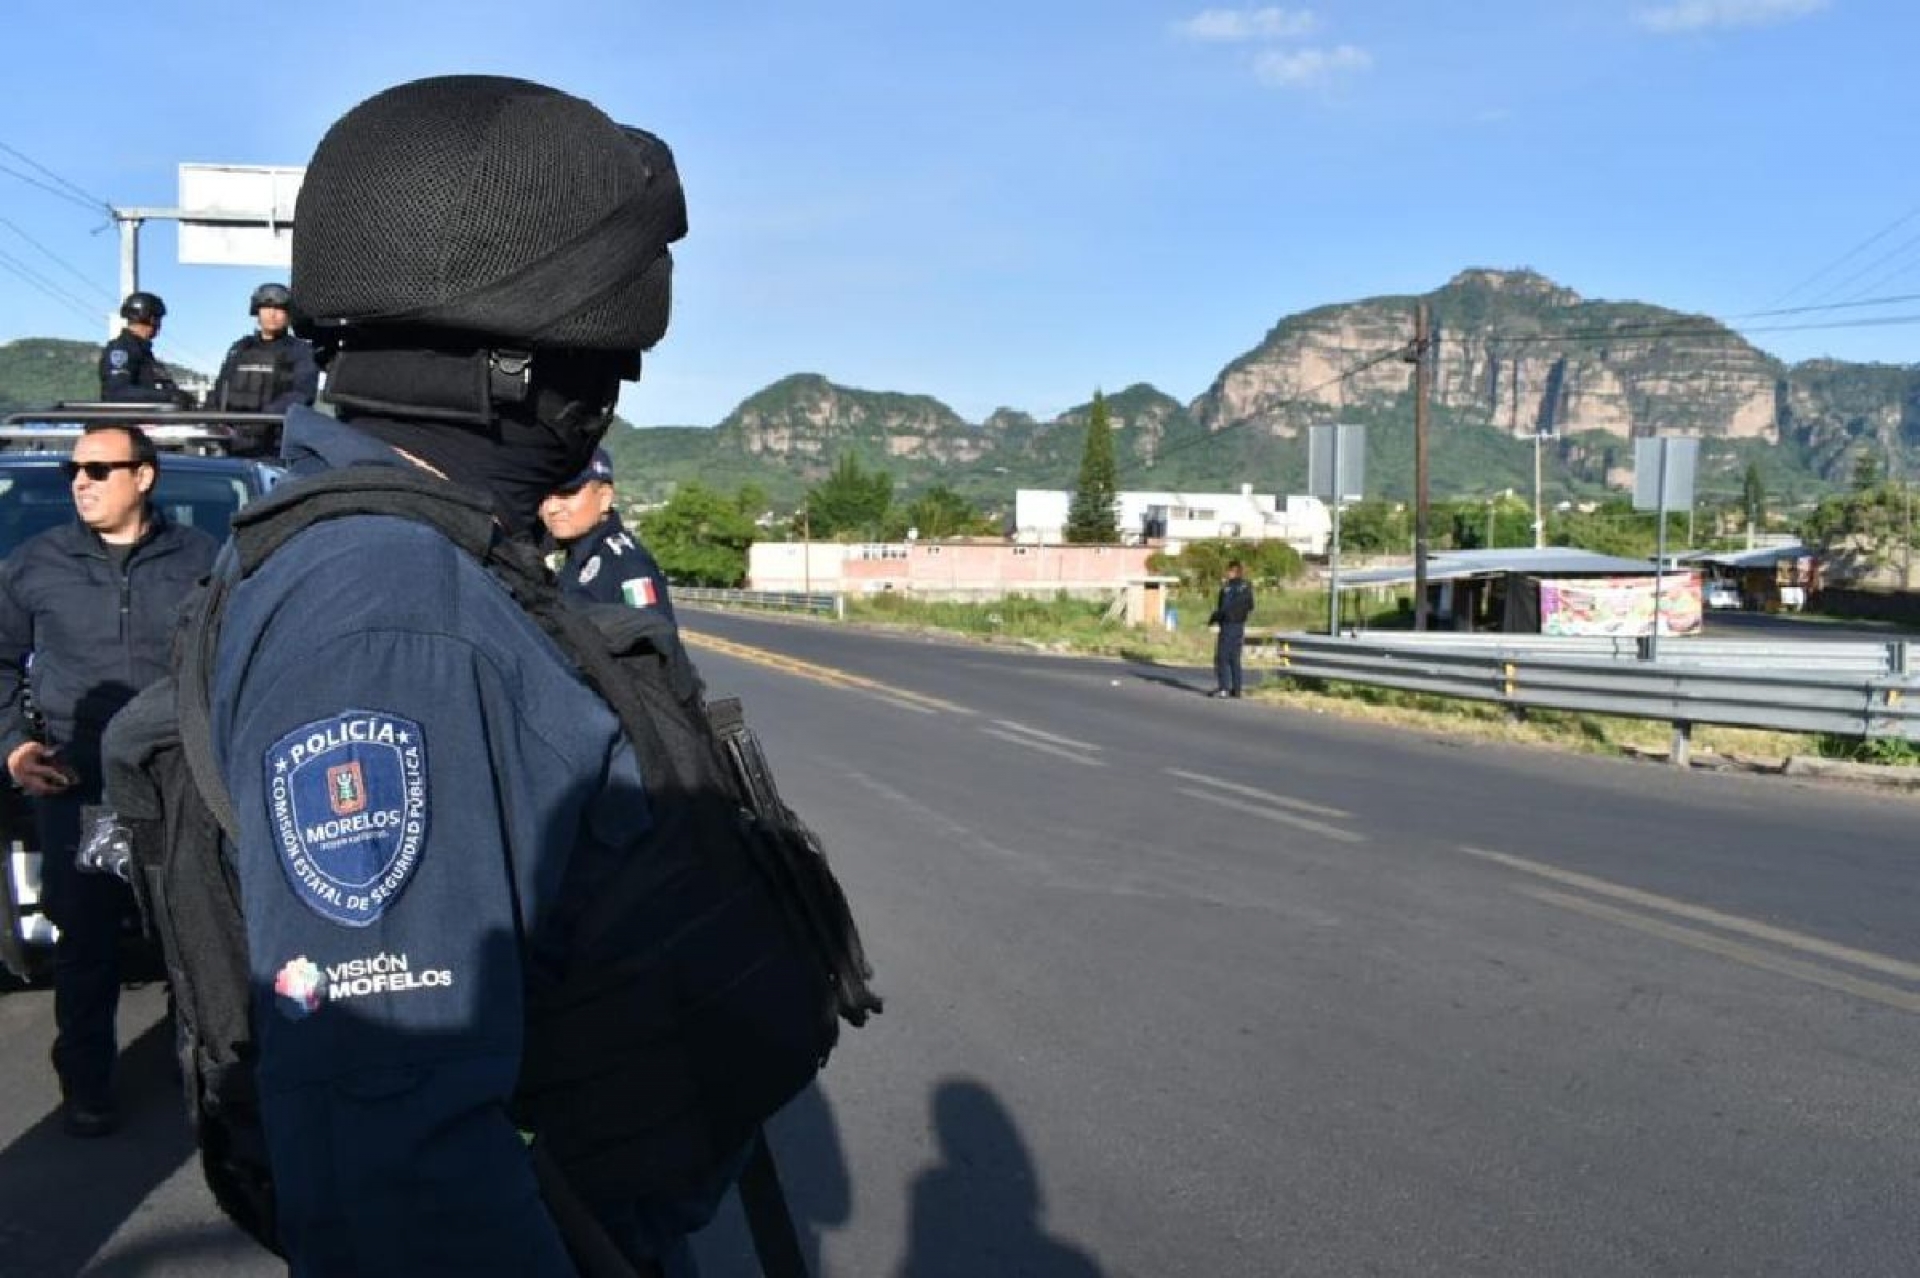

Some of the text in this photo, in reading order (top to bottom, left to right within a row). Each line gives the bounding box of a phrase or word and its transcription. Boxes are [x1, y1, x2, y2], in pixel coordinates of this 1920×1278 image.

[290, 718, 394, 764] POLICÍA
[306, 810, 401, 843] MORELOS
[293, 858, 342, 906] ESTATAL
[346, 895, 369, 911] DE
[370, 820, 421, 904] SEGURIDAD
[326, 951, 408, 982] VISIÓN
[329, 970, 452, 1001] MORELOS
